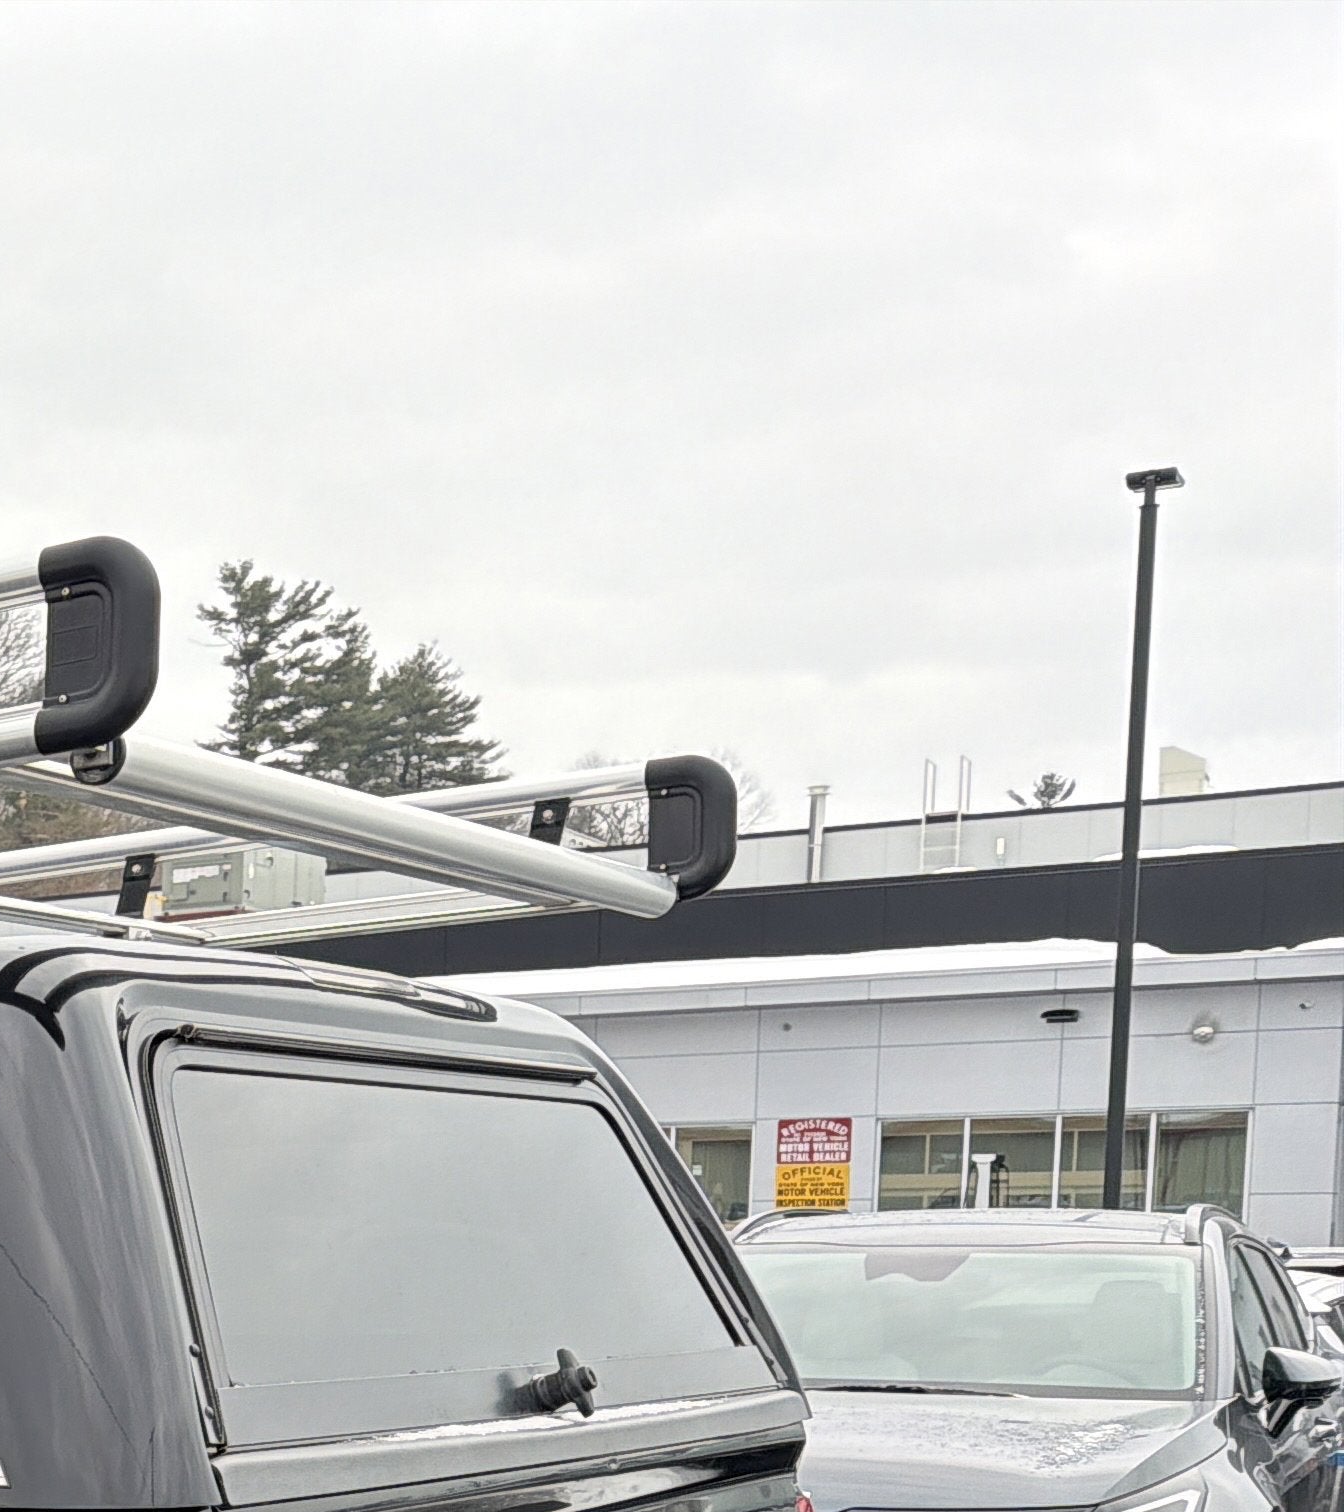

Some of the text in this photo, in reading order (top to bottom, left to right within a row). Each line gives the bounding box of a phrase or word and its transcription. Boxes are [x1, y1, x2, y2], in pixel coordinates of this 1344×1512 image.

[780, 1119, 849, 1137] REGISTERED
[779, 1141, 849, 1152] MOTOR VEHICLE
[780, 1151, 847, 1163] RETAIL DEALER
[782, 1166, 843, 1181] OFFICIAL
[777, 1187, 845, 1197] MOTOR VEHICLE
[776, 1198, 846, 1208] INSPECTION STATION
